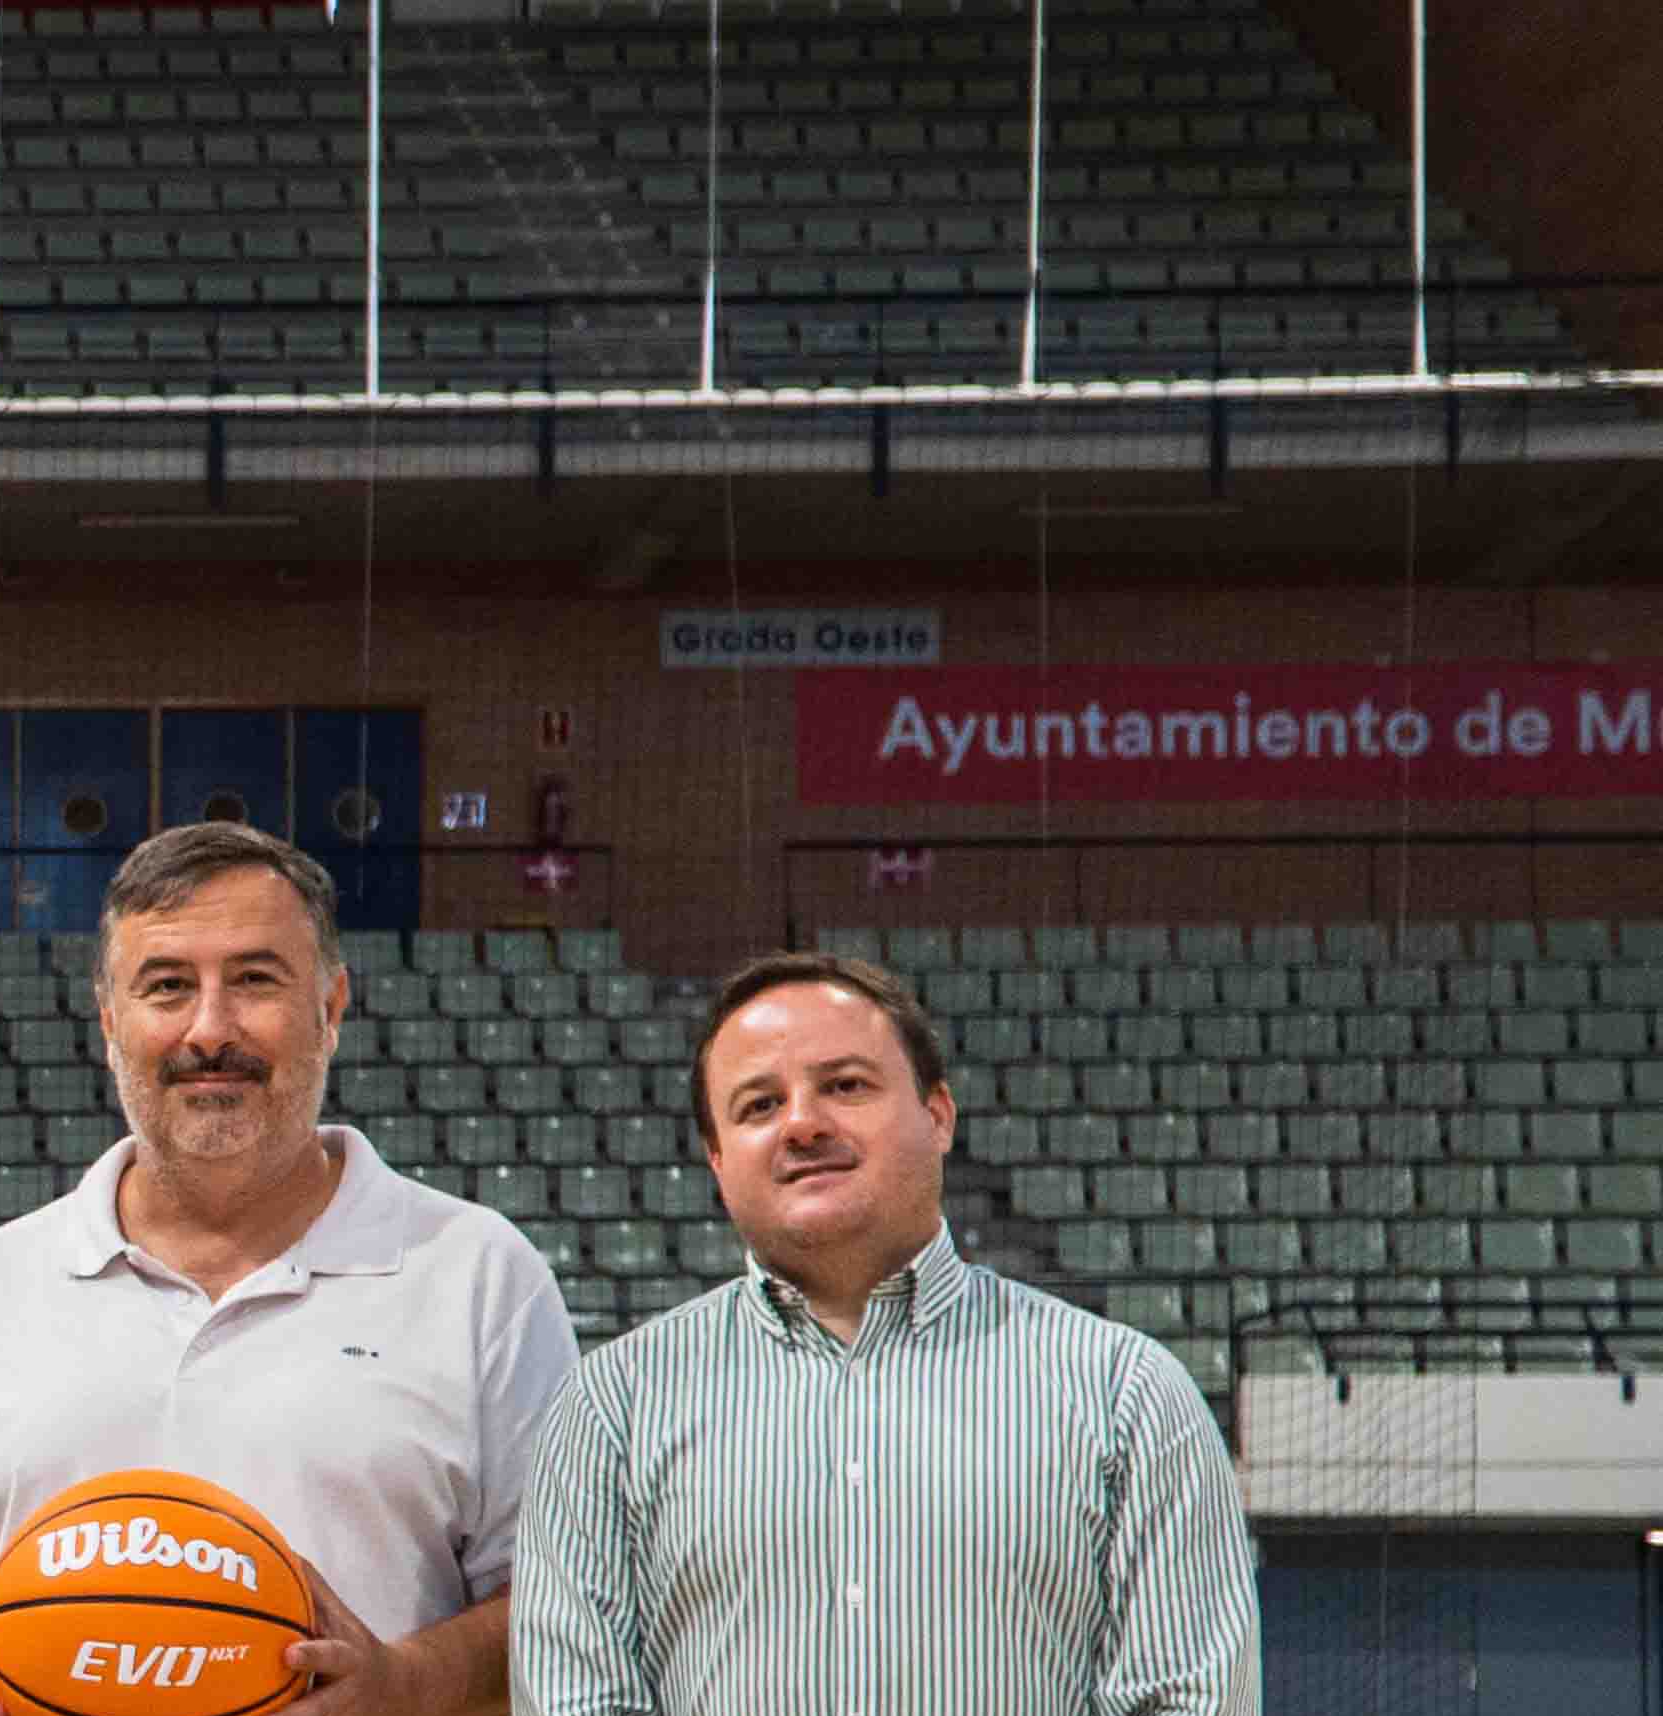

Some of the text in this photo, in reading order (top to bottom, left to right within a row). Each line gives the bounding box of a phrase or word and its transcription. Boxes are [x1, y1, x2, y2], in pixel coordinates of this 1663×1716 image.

[880, 687, 1663, 776] Ayuntamiento de M
[36, 1516, 259, 1593] Wilson
[69, 1639, 250, 1688] EVO NXT
